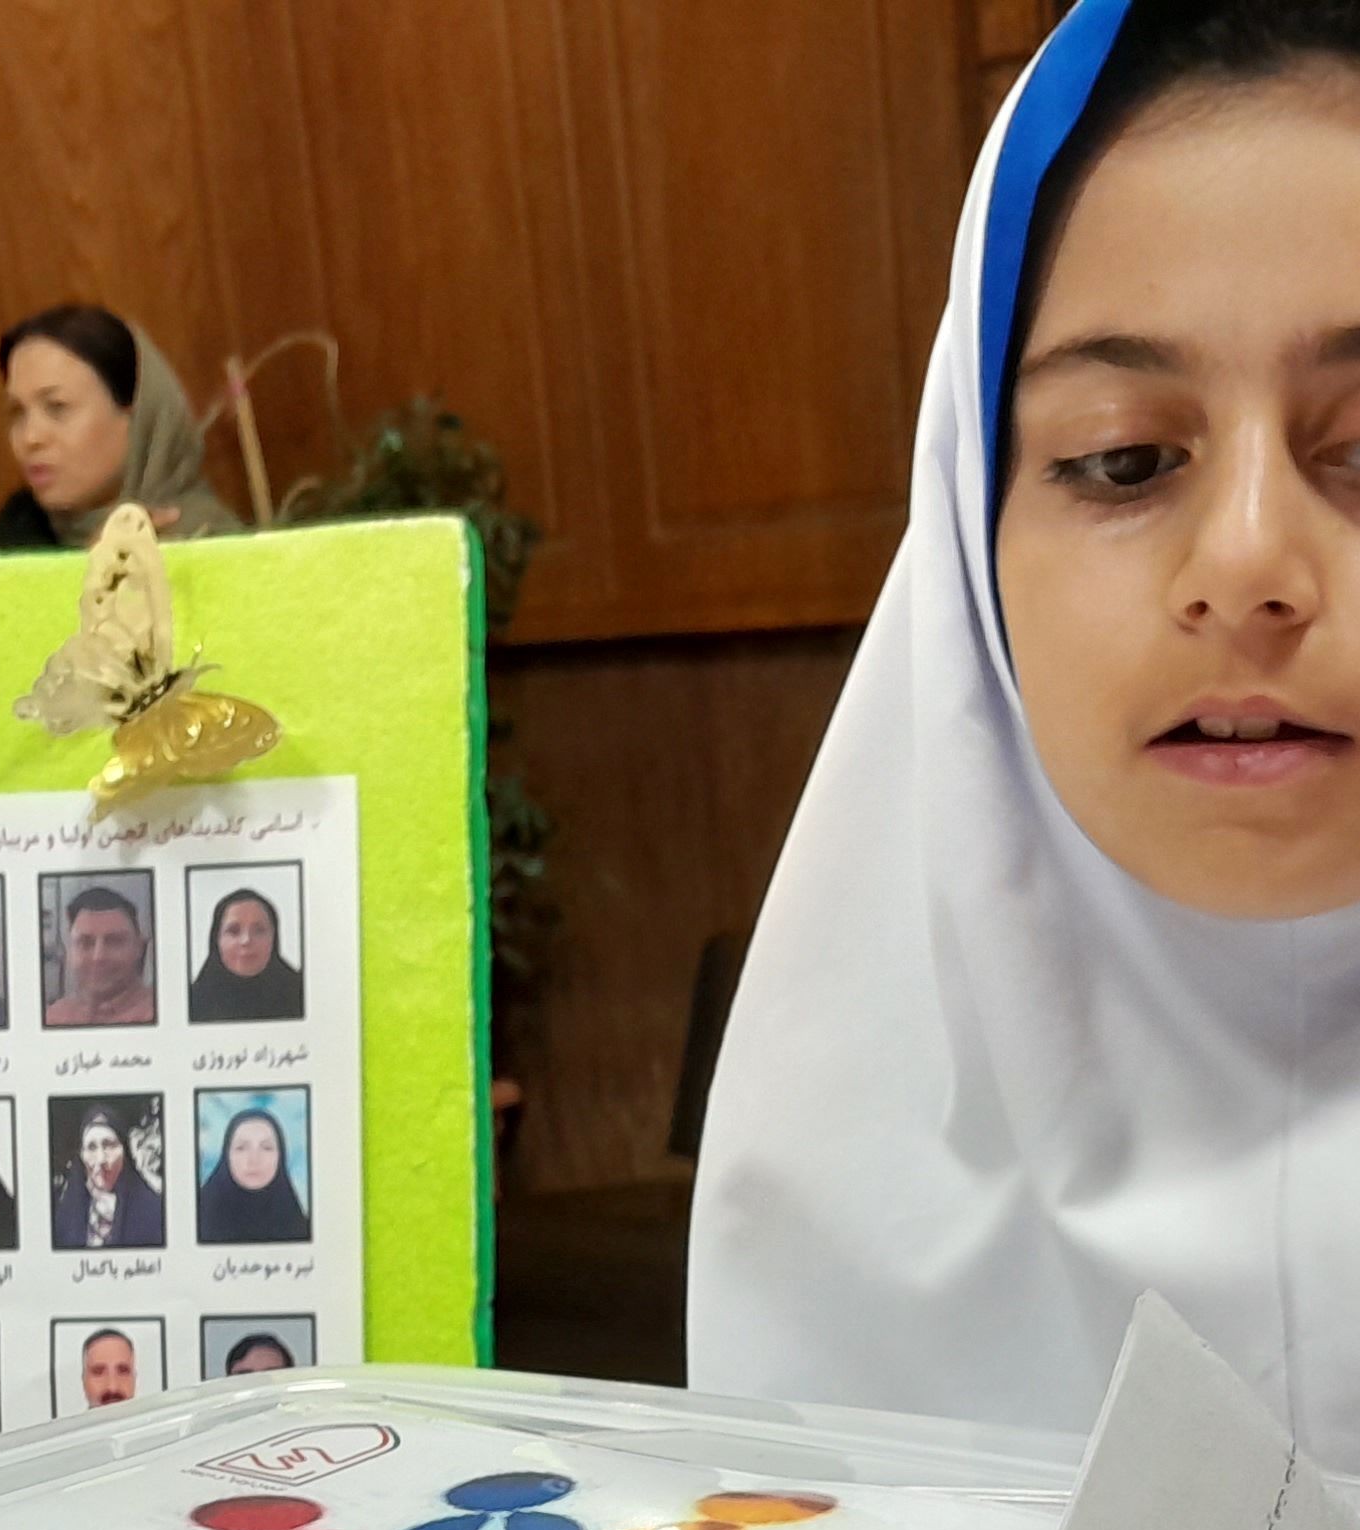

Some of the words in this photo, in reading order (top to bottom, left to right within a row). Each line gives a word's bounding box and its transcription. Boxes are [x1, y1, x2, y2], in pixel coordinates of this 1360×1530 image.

[110, 1054, 152, 1067] محمد
[193, 1049, 247, 1070] نوروزی
[254, 1043, 309, 1066] شهرزاد
[123, 1258, 161, 1279] اعظم
